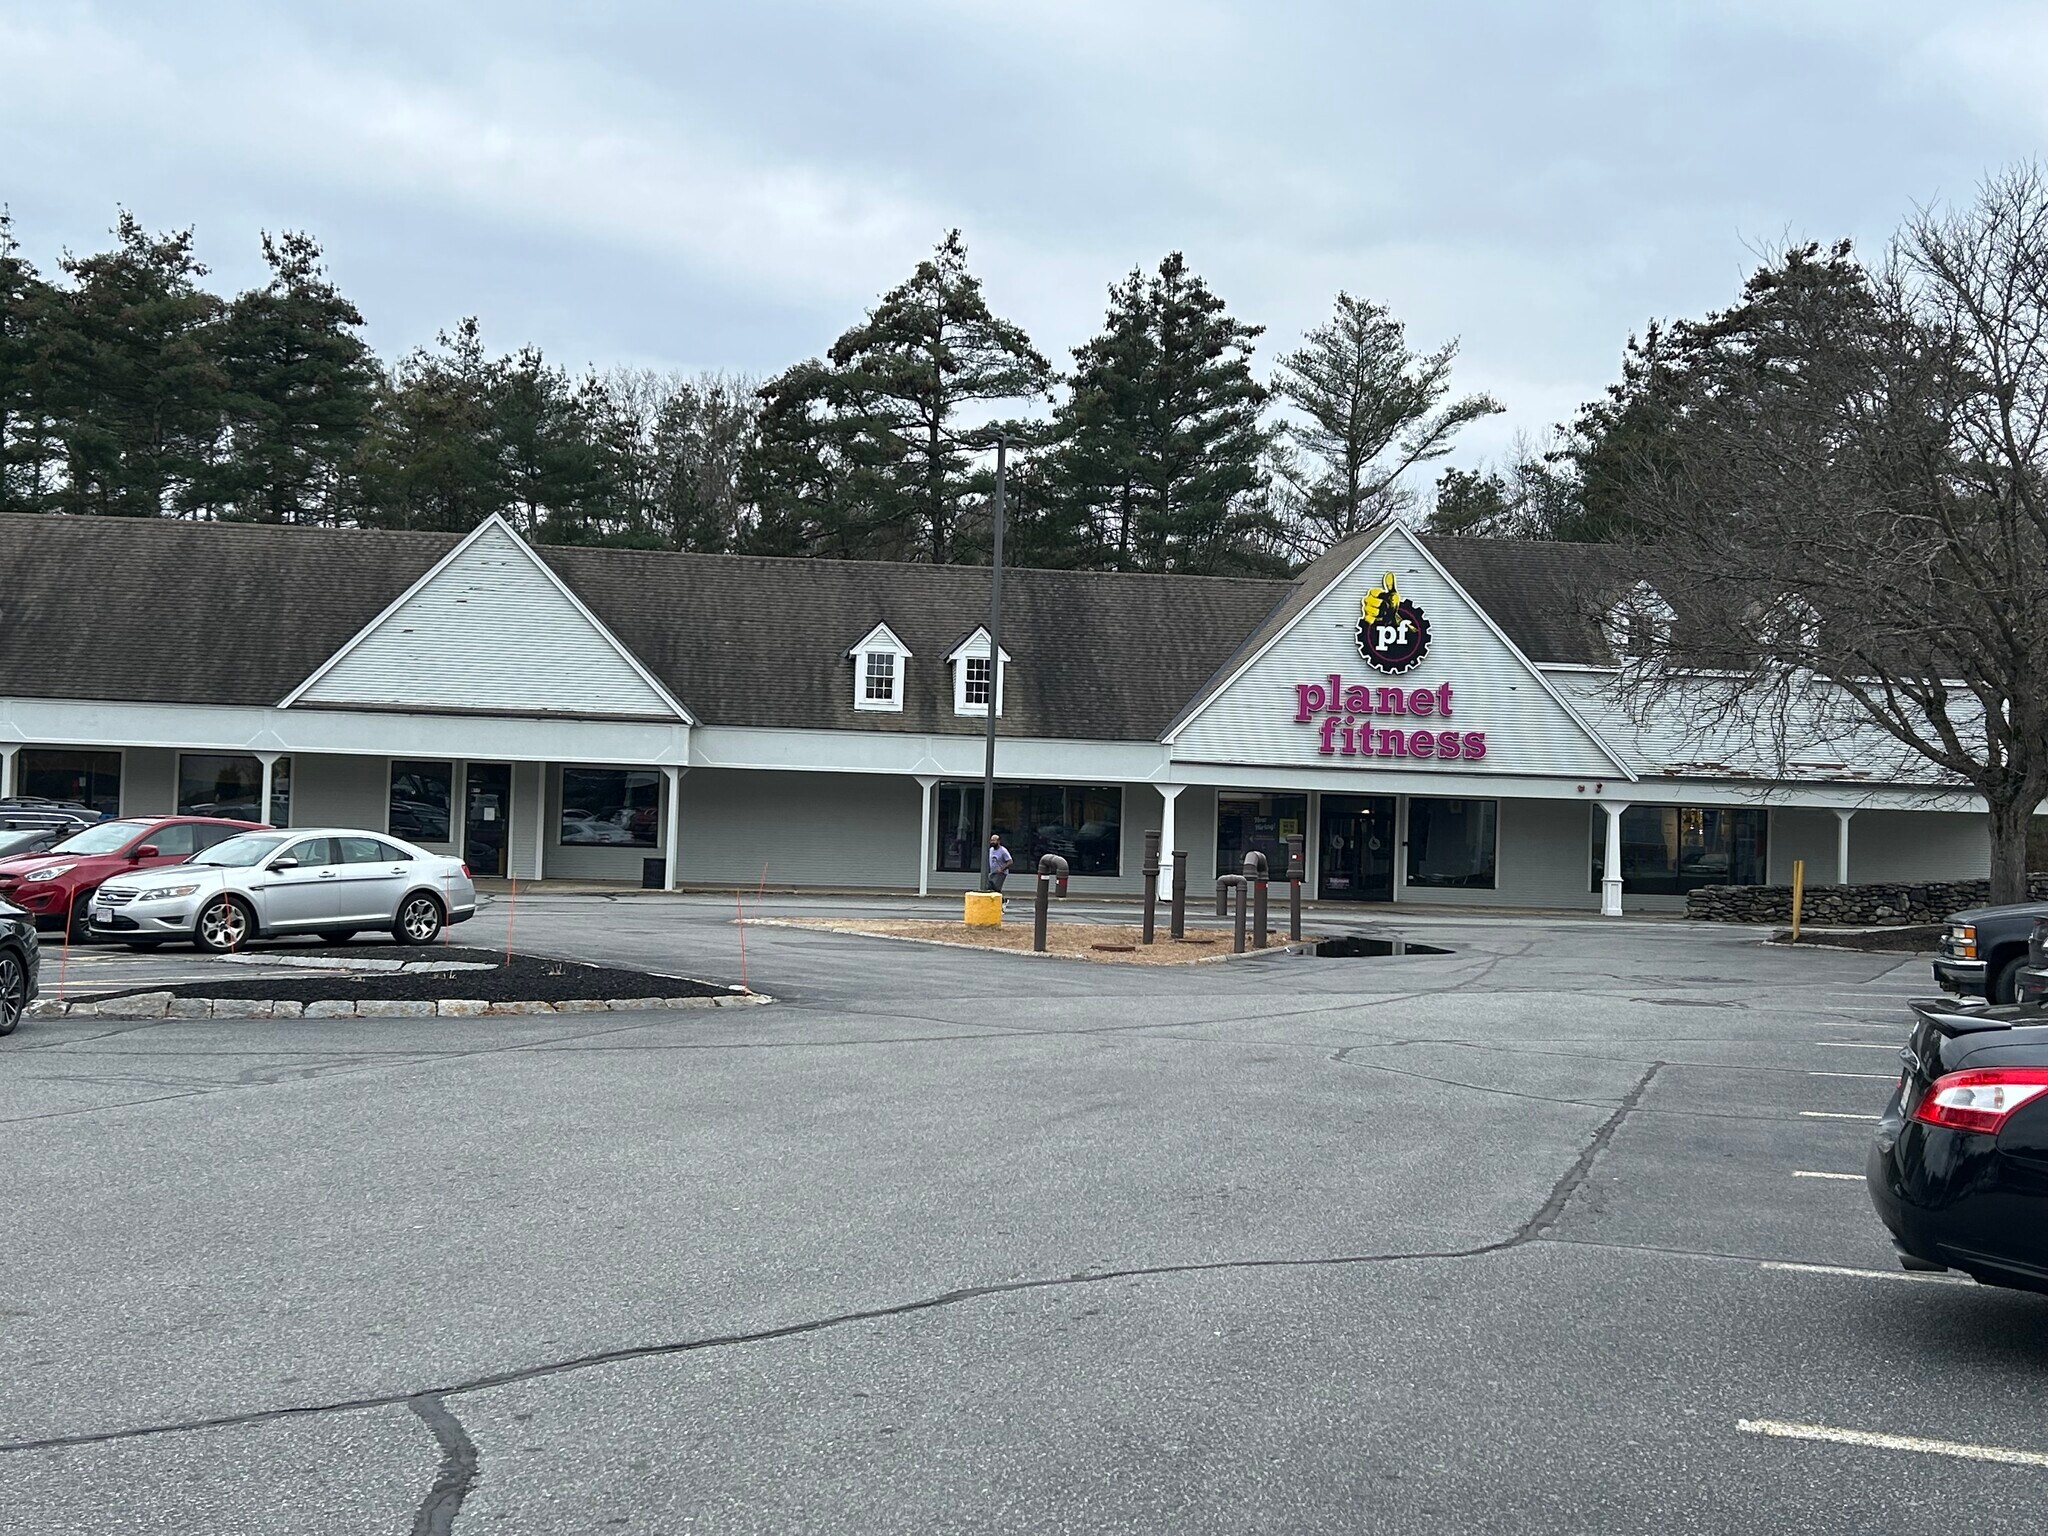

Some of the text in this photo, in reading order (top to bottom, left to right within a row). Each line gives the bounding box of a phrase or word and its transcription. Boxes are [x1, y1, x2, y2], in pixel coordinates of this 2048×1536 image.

[1375, 619, 1413, 651] pf
[1294, 674, 1454, 722] planet
[1318, 715, 1487, 760] fitness
